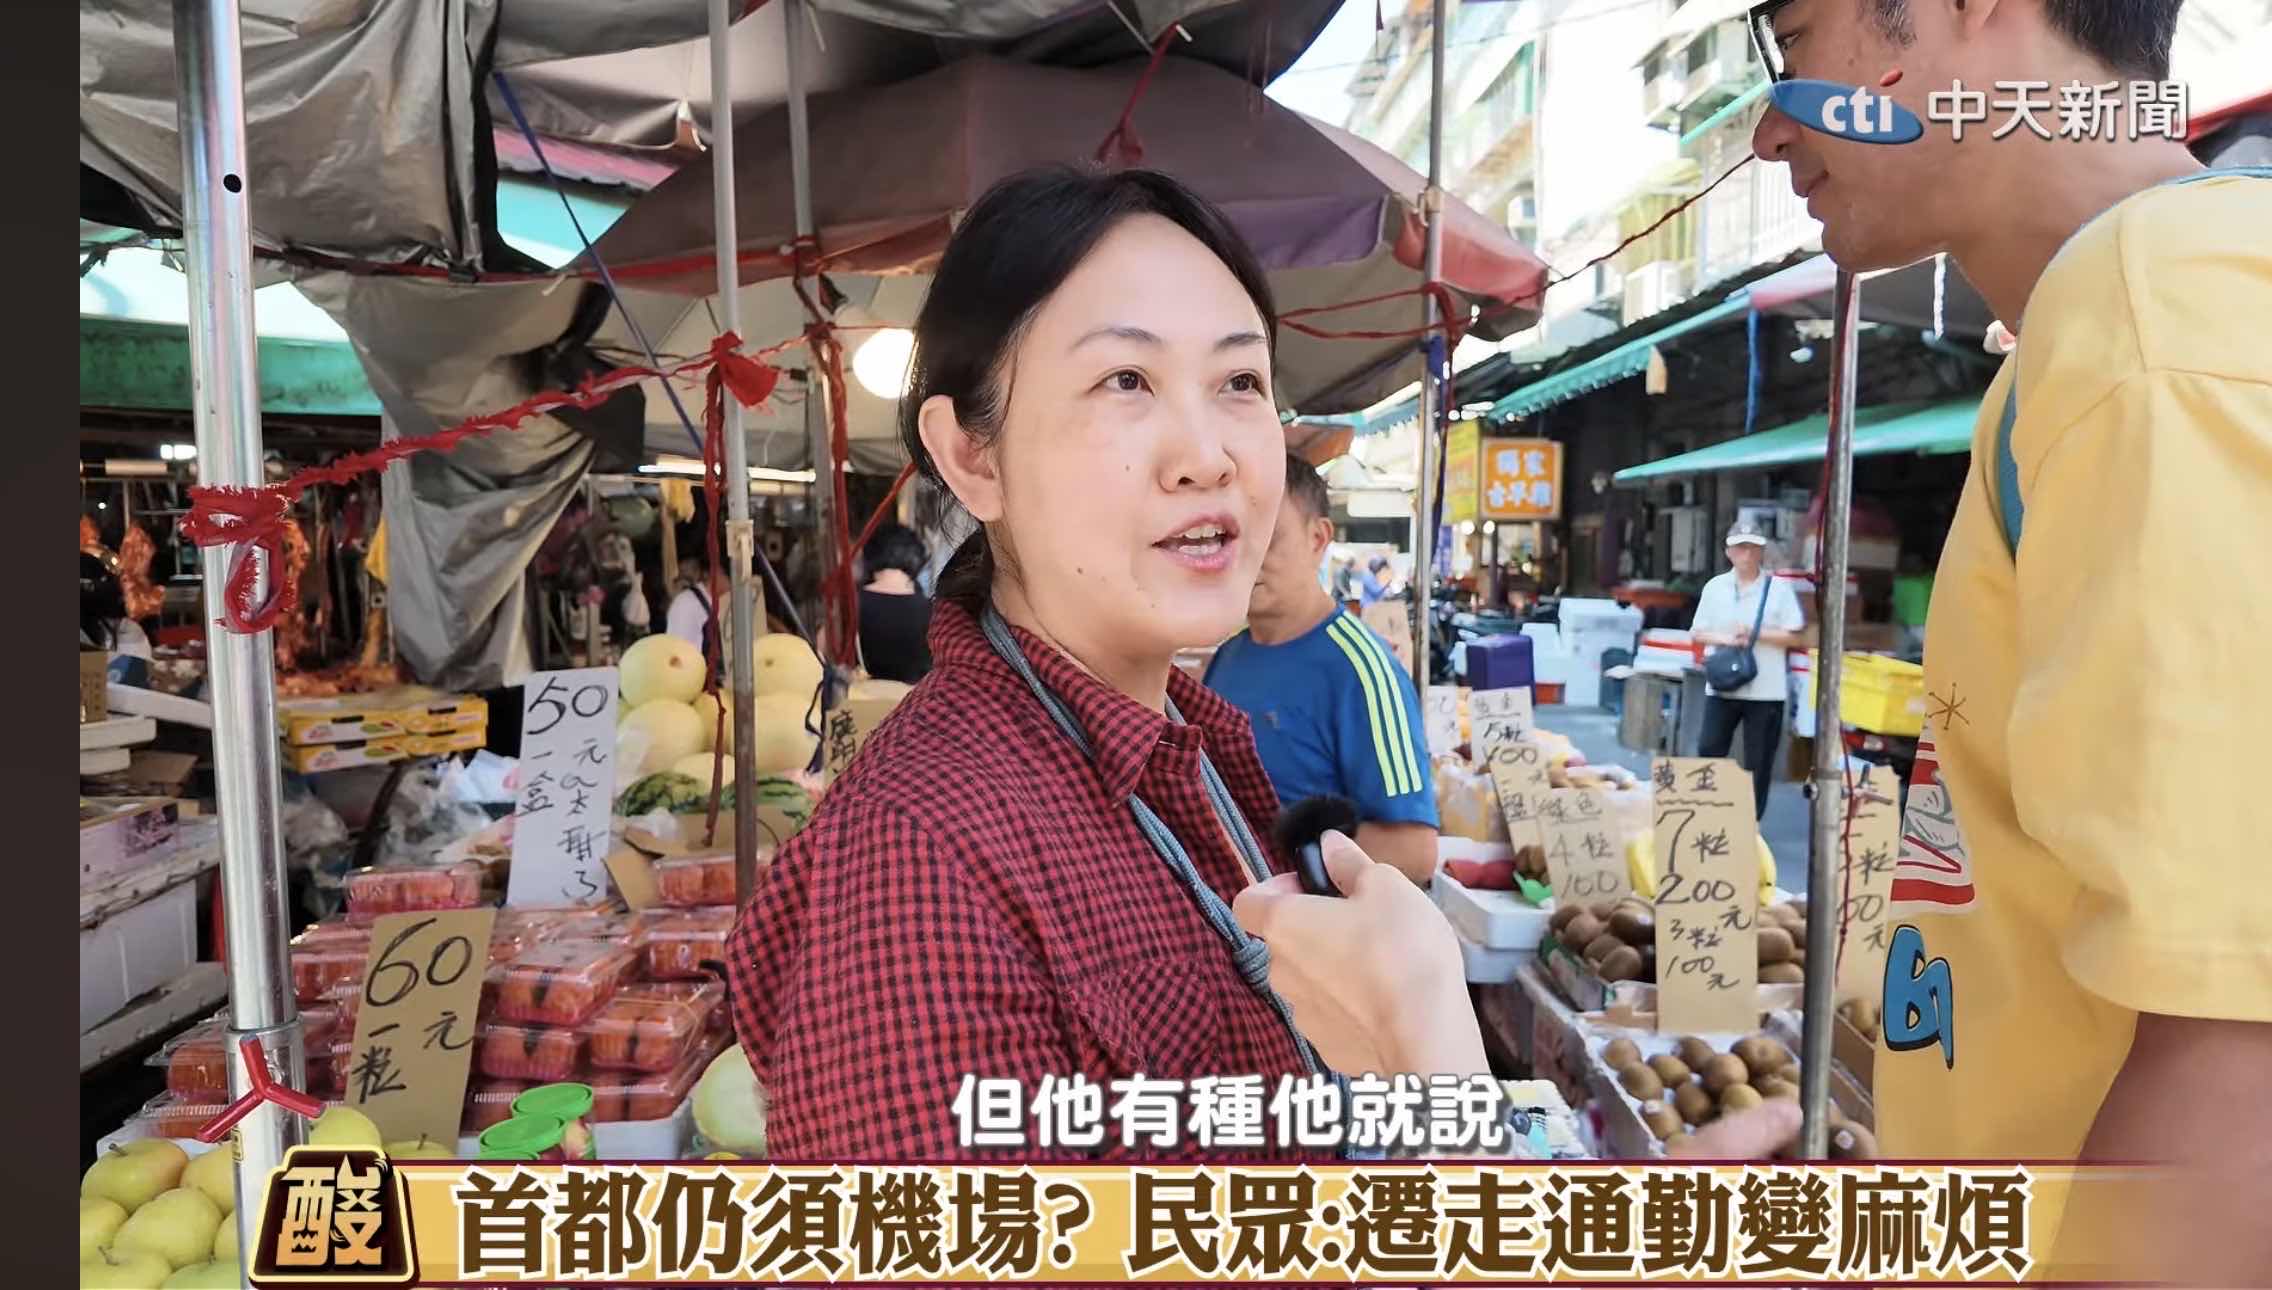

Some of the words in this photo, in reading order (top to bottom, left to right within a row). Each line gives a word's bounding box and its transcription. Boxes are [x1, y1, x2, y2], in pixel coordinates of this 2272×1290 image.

[527, 676, 608, 735] 50
[1656, 809, 1729, 873] 7粒
[366, 917, 473, 1007] 60
[423, 1011, 475, 1050] 元
[351, 1023, 407, 1104] 一粒
